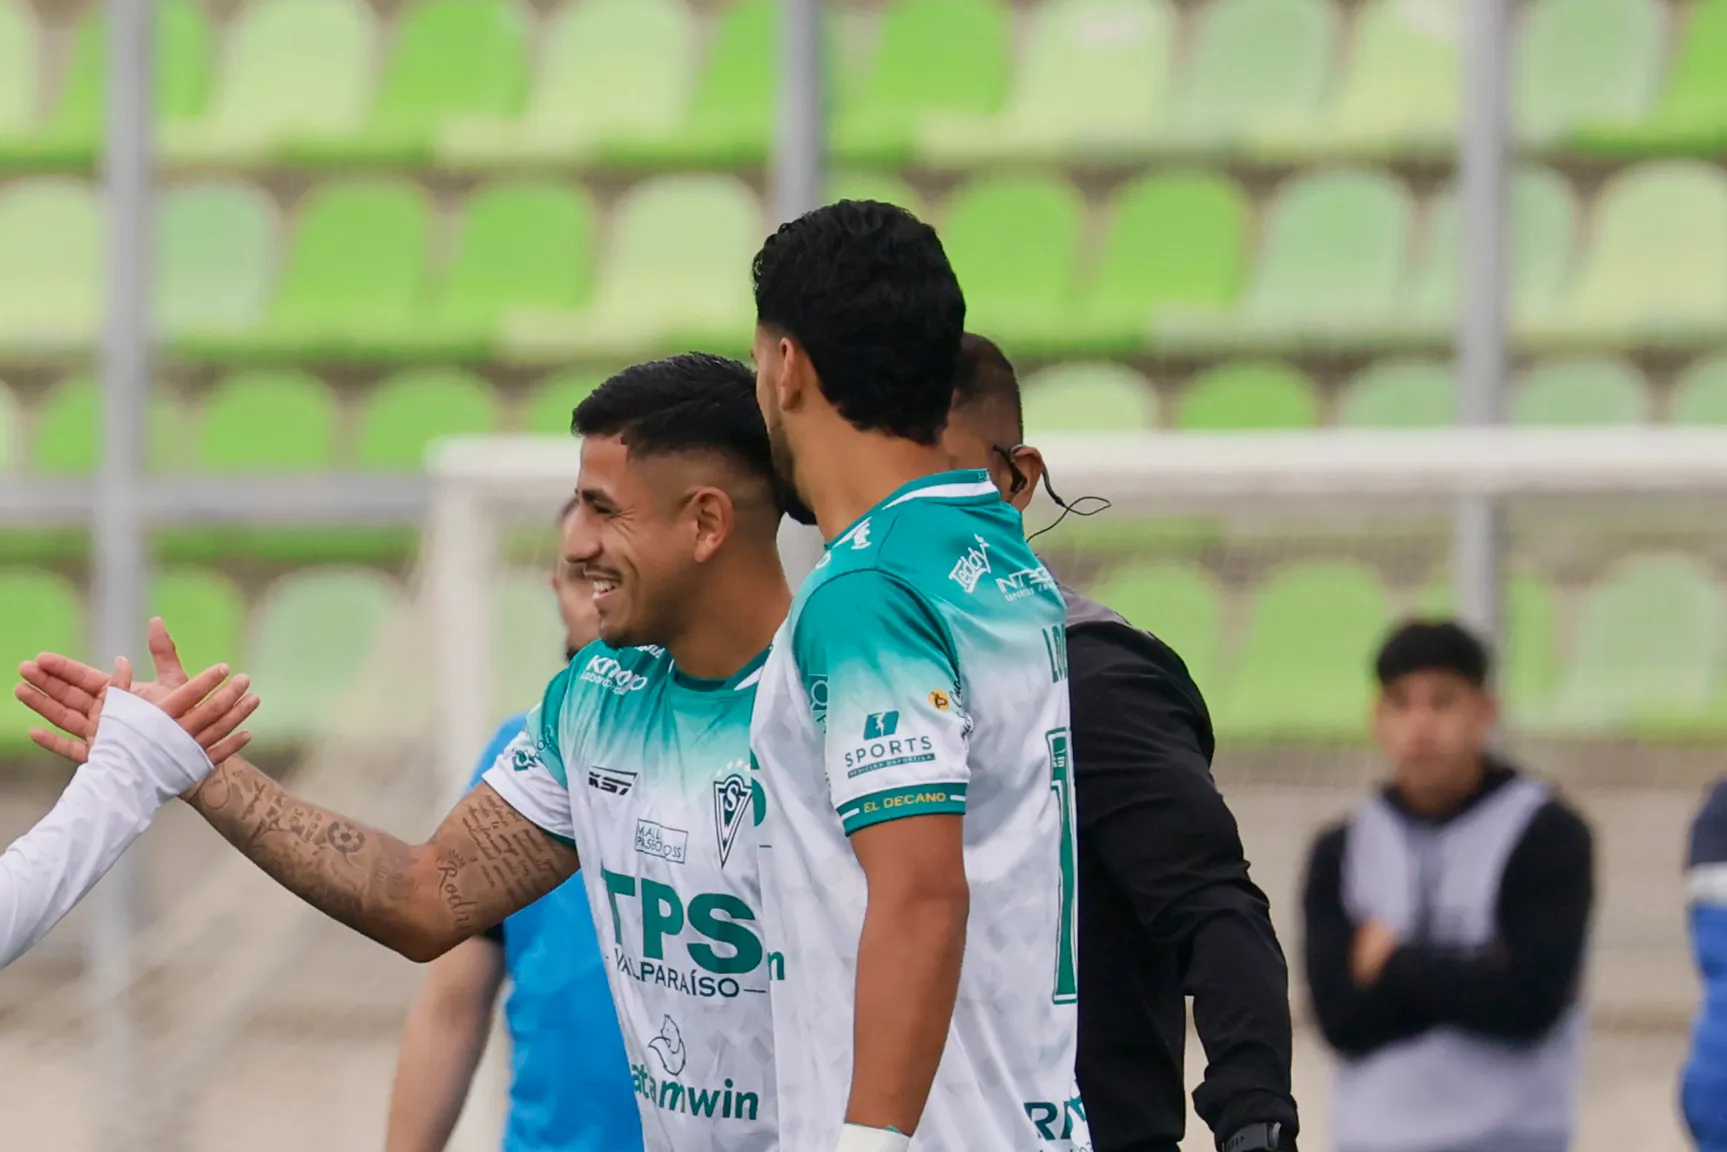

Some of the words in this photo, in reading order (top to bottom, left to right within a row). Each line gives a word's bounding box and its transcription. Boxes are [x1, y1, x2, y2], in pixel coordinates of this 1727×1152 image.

[845, 736, 932, 767] SPORTS
[864, 802, 879, 813] EL
[883, 792, 947, 808] DECANO
[663, 844, 682, 858] OSS
[601, 867, 764, 976] TPS
[631, 1063, 759, 1120] atamwin
